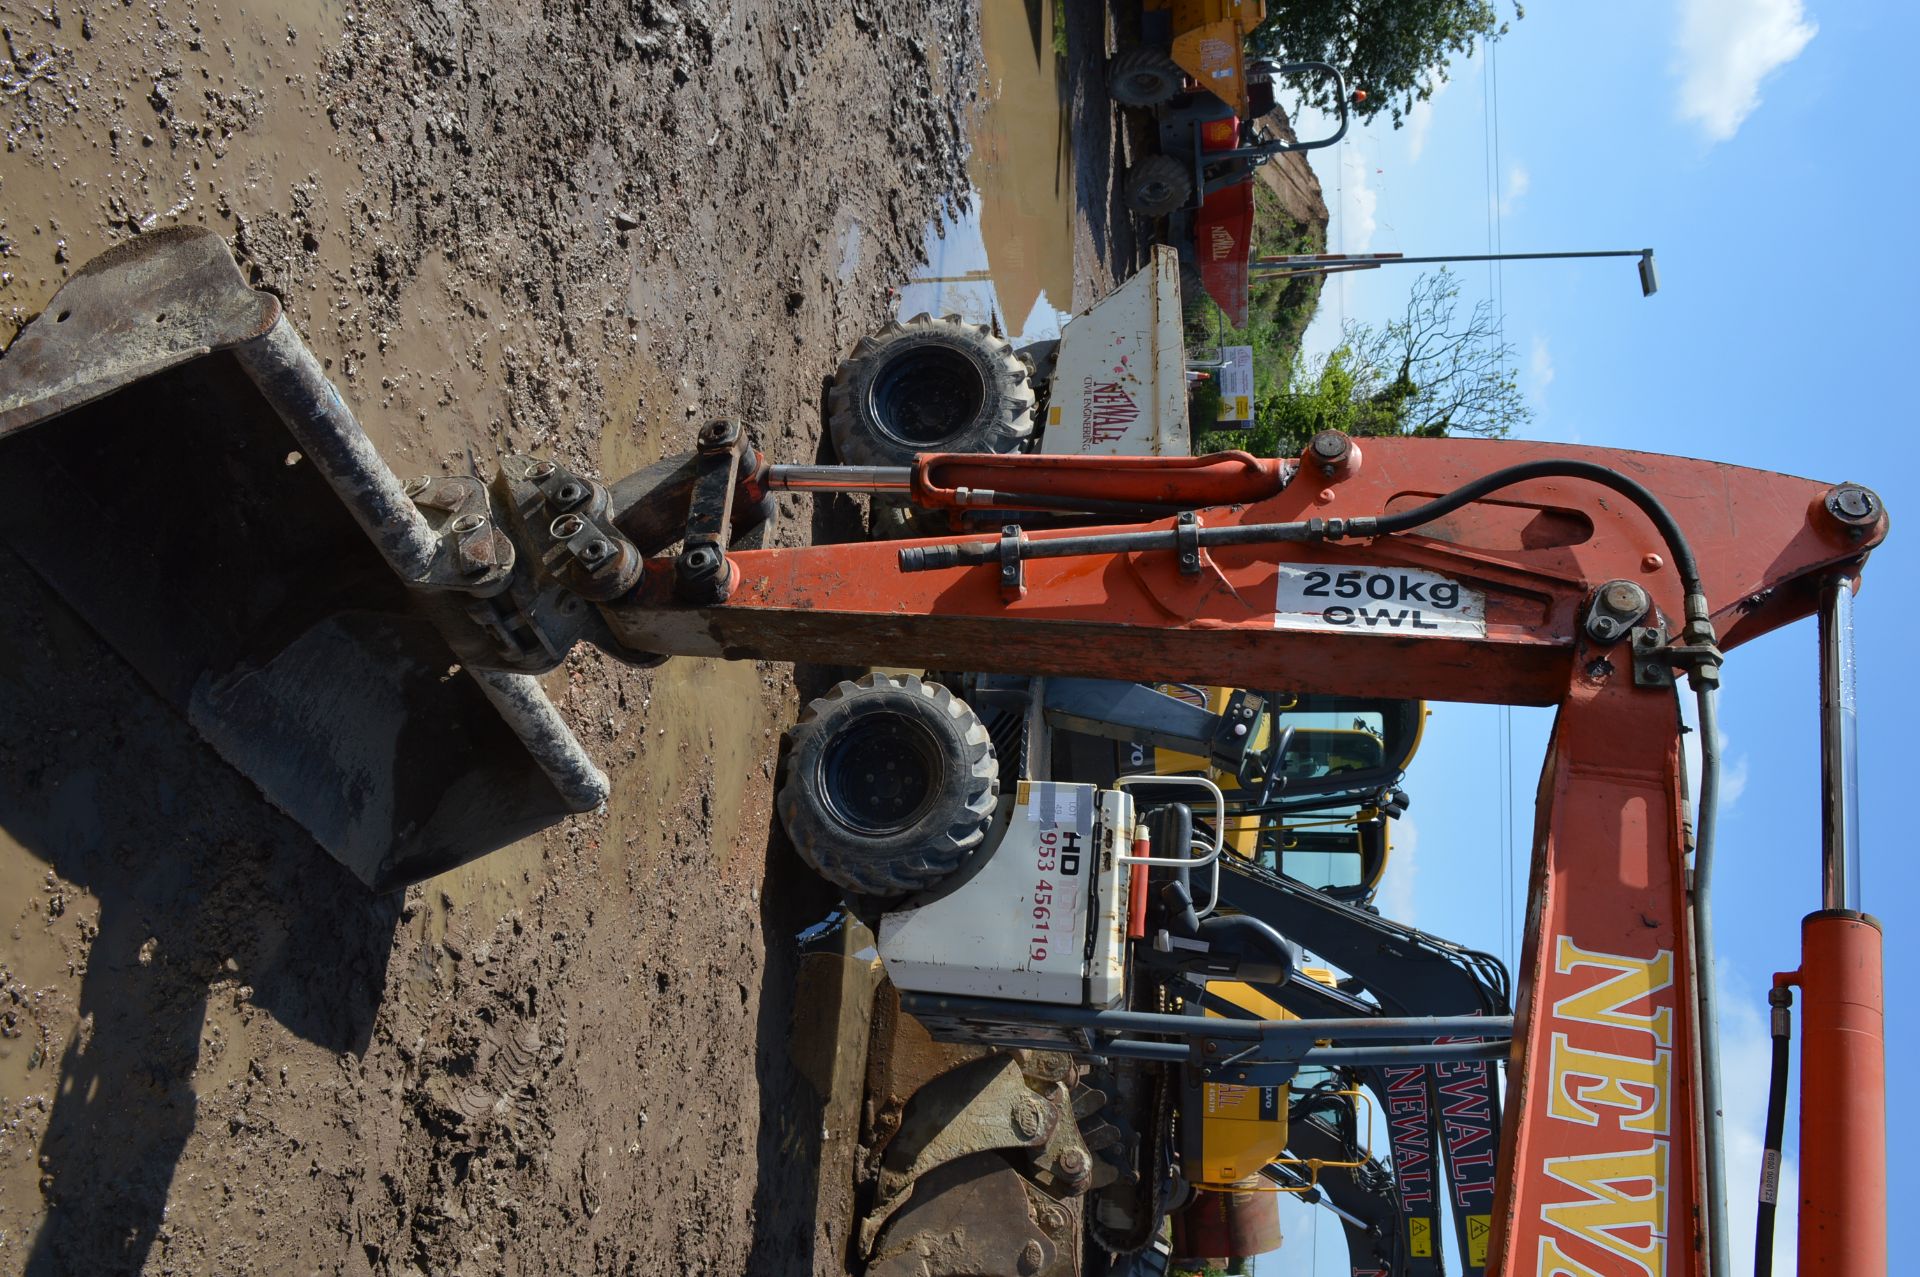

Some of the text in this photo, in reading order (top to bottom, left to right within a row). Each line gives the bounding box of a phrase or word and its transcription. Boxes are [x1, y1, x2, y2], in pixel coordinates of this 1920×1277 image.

[1211, 226, 1235, 260] NEWALL
[1082, 376, 1092, 450] CIVIL ENGINEERING
[1092, 381, 1141, 444] NEWALL
[1302, 571, 1459, 610] 250kg
[1031, 822, 1058, 962] 953 456119
[1218, 1083, 1249, 1108] ALL
[1384, 1064, 1432, 1212] NEWALL
